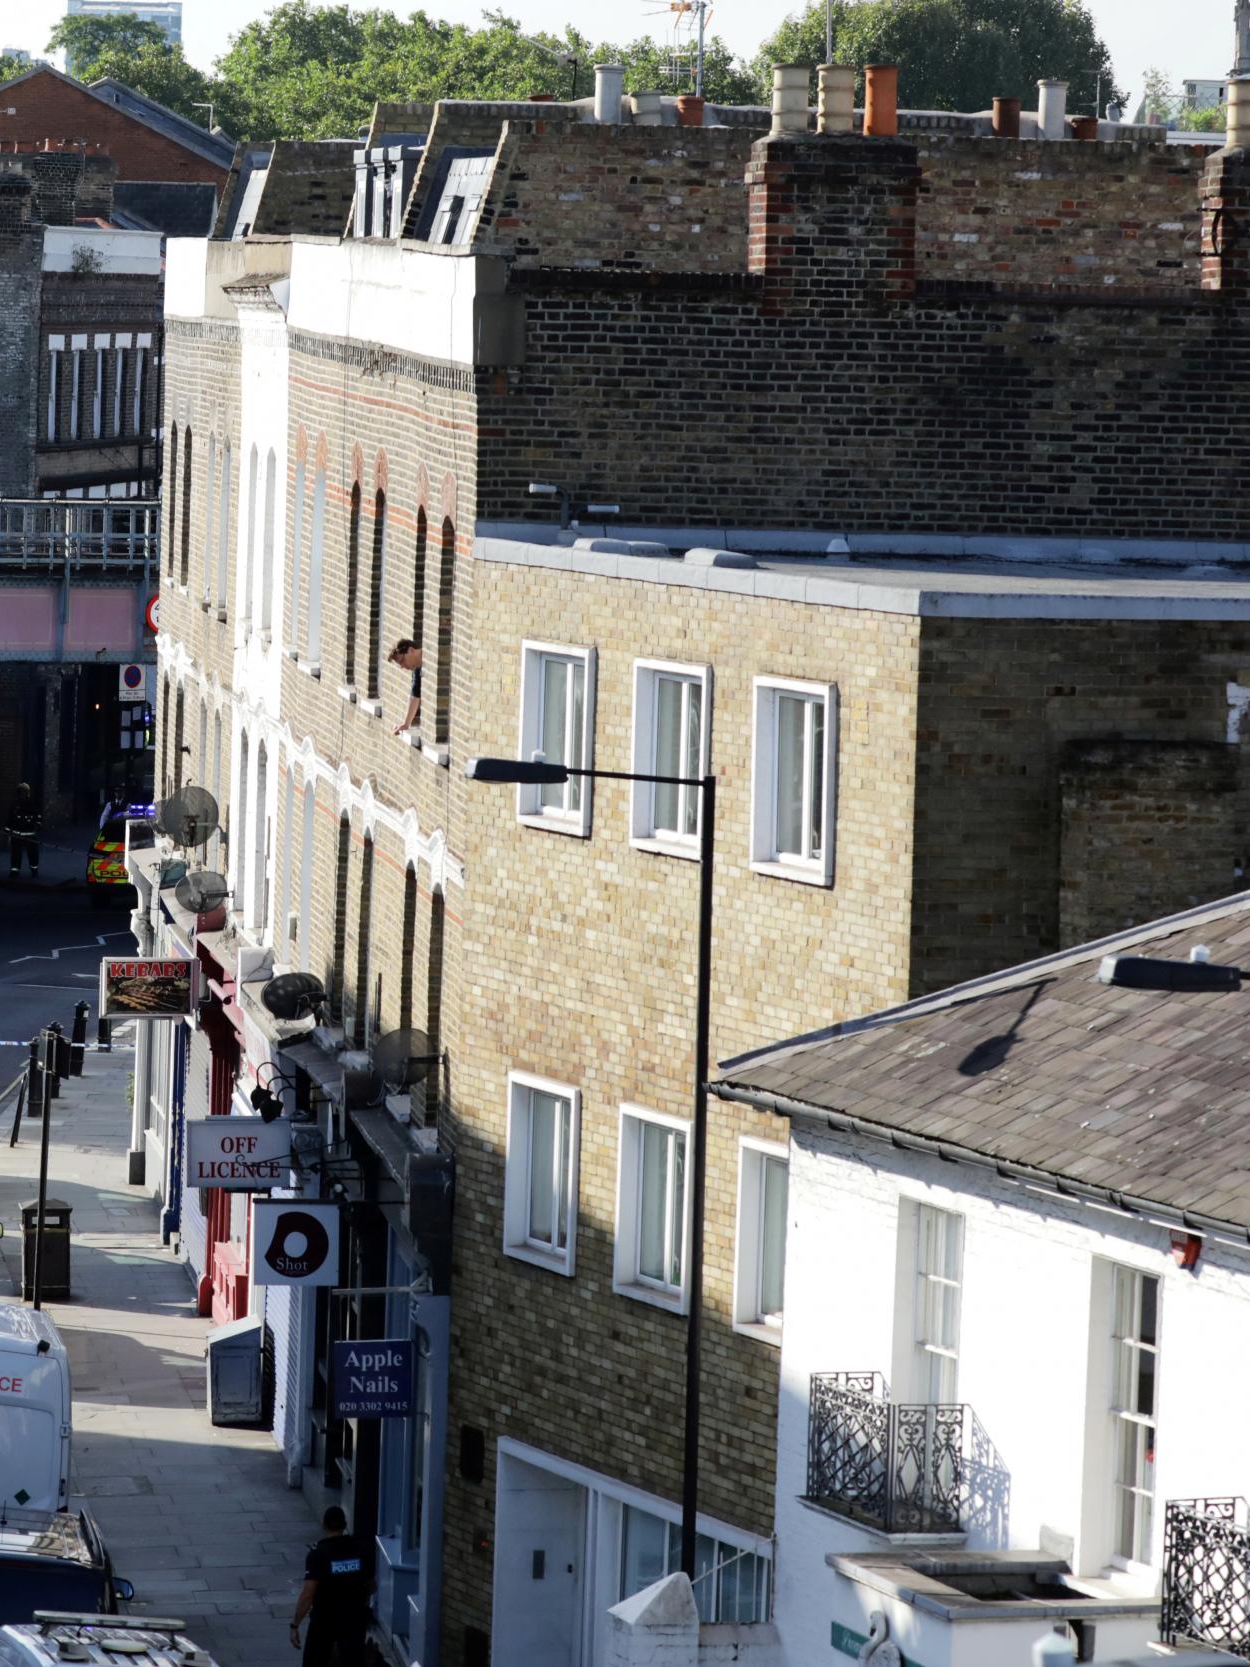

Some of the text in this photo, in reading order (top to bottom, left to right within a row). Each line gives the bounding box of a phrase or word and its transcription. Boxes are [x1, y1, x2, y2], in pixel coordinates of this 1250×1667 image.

[110, 962, 186, 978] KEBABS
[220, 1137, 258, 1154] OFF
[197, 1161, 281, 1179] LICENCE
[276, 1257, 308, 1271] Shot
[344, 1350, 403, 1371] Apple
[350, 1376, 398, 1393] Nails
[339, 1401, 408, 1411] 020 3302 9415
[332, 1562, 360, 1573] POLICE
